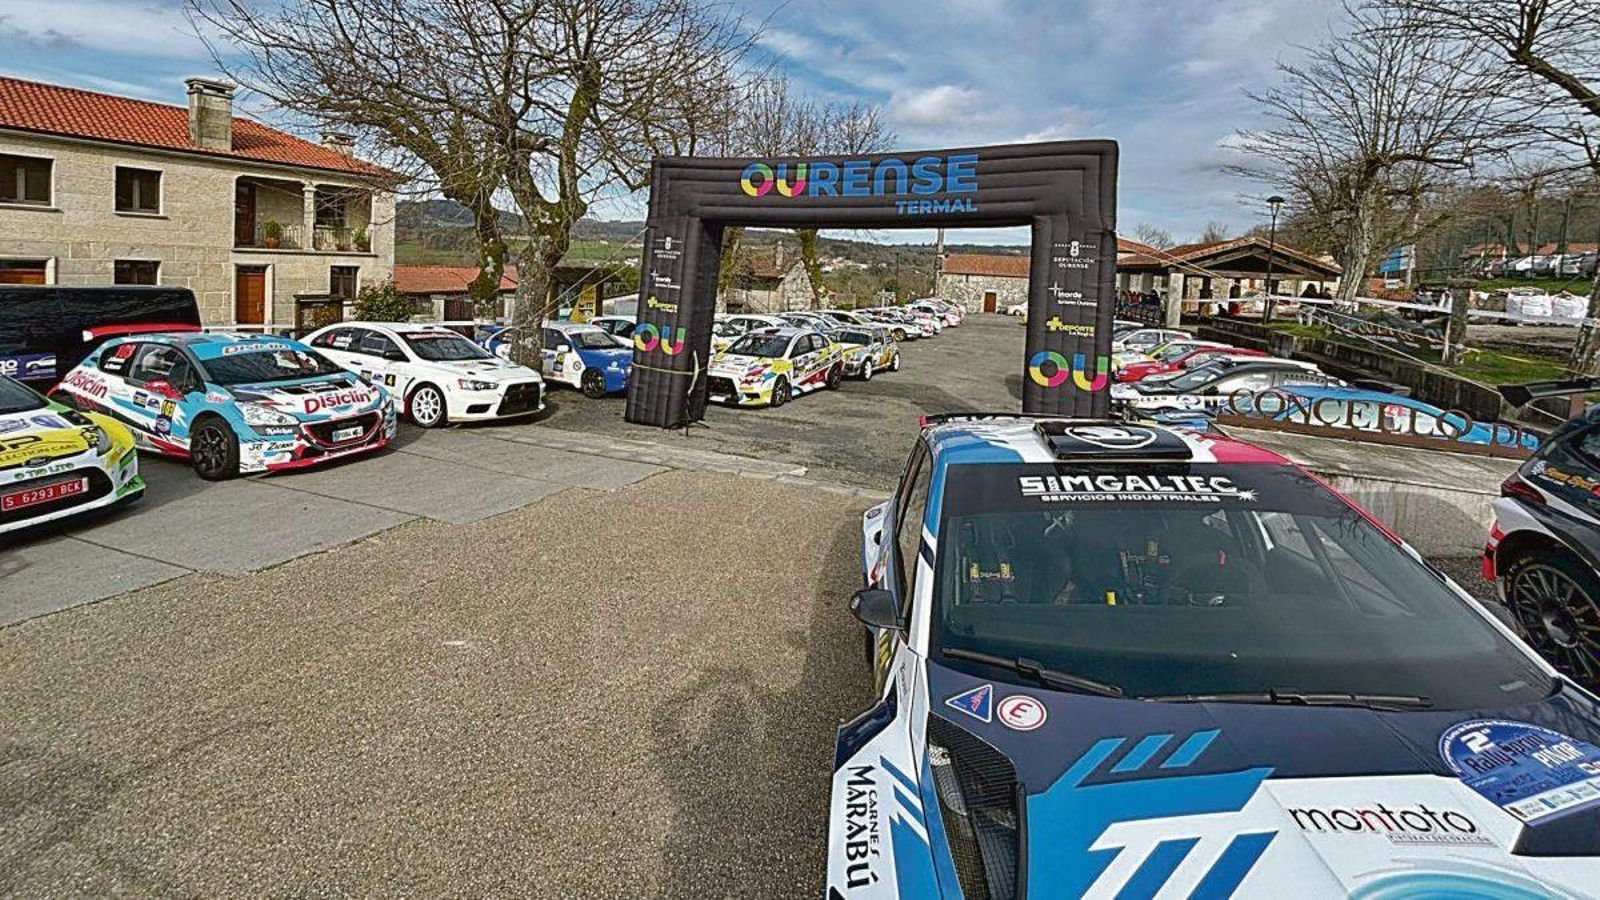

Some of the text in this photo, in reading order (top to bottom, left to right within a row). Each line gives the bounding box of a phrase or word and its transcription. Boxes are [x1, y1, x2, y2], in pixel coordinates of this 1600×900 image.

[741, 154, 979, 197] OURENSE
[896, 198, 978, 215] TERMAL
[634, 323, 686, 355] OU
[1029, 351, 1109, 391] OU
[304, 389, 372, 414] Disiclin
[1228, 387, 1473, 439] CONCELLO
[22, 487, 54, 503] 6293
[60, 482, 81, 495] BCK
[1019, 475, 1238, 493] SIMGALTEC
[1118, 494, 1221, 502] INDUSTRIALES
[1010, 702, 1033, 719] E
[846, 764, 879, 889] MARABÚ
[868, 789, 880, 858] CARNES
[1288, 803, 1477, 833] montoto
